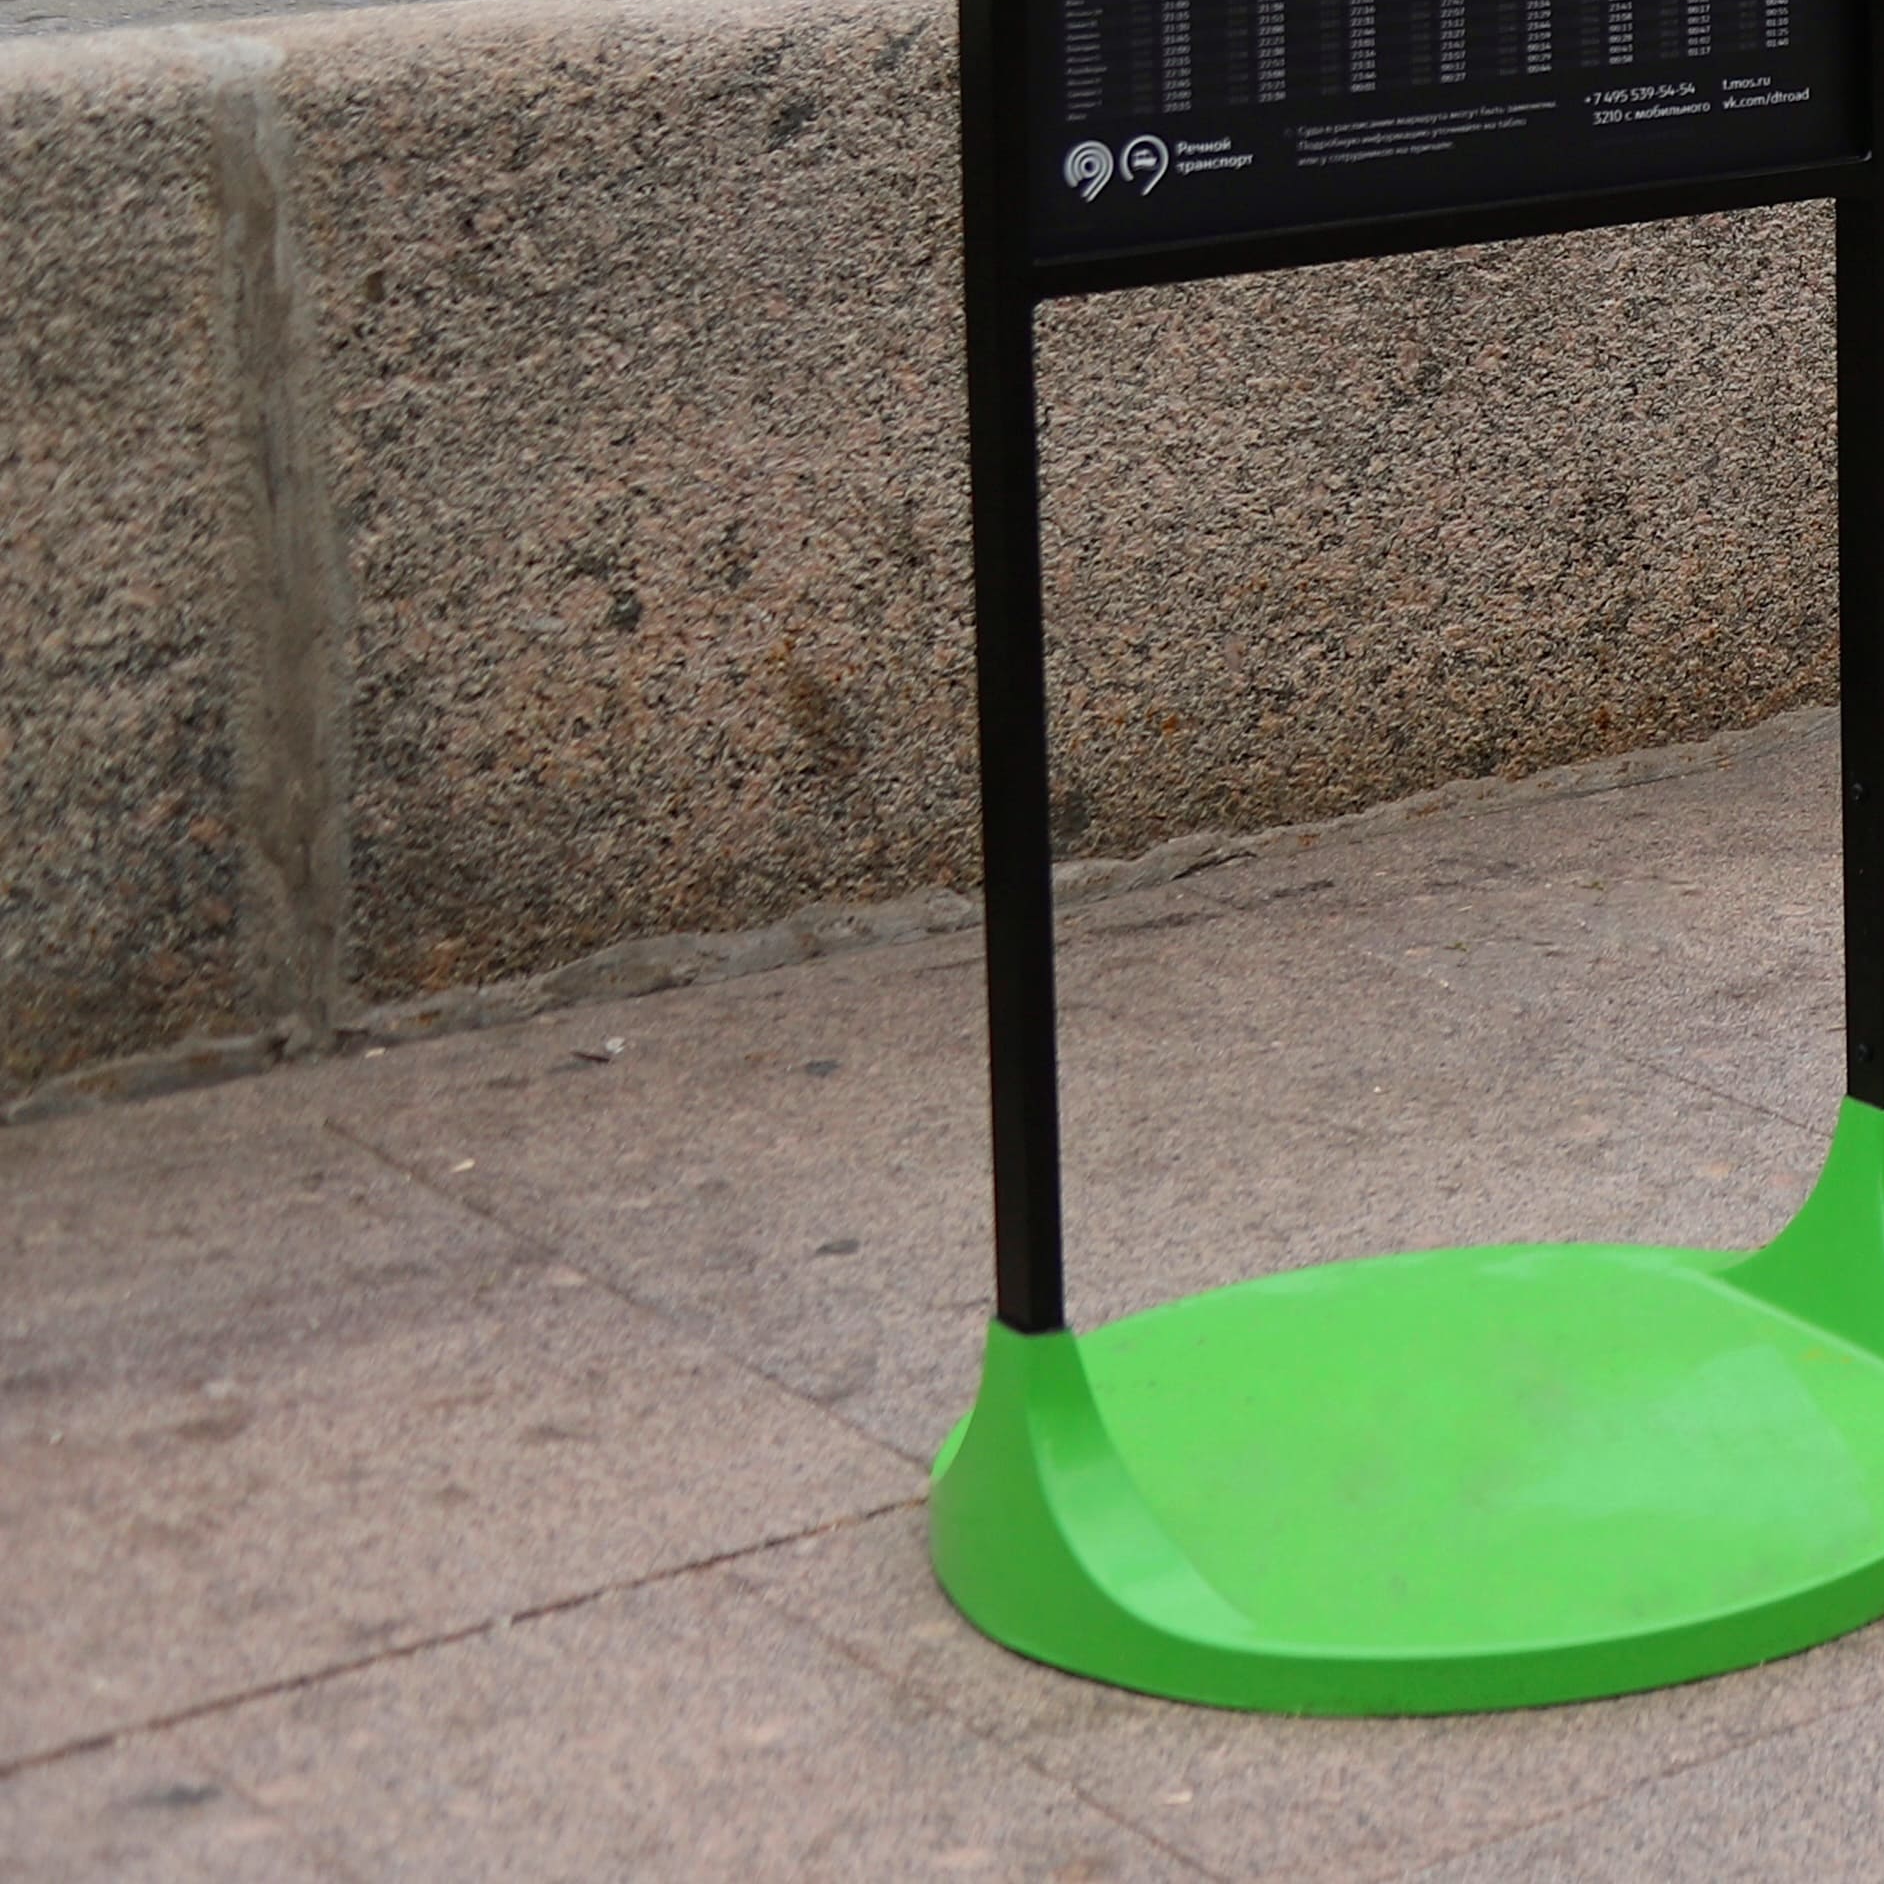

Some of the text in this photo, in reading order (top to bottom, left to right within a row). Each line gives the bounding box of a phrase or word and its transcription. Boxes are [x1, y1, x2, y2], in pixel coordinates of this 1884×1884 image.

[1604, 88, 1629, 104] 495
[1631, 82, 1696, 102] 539-54-54
[1722, 75, 1771, 91] t.mos.ru
[1593, 109, 1623, 126] 3210
[1634, 100, 1711, 120] мобильного
[1722, 87, 1811, 111] vk.com/dtroad
[1176, 135, 1232, 156] Речной
[1176, 152, 1254, 177] транспорт
